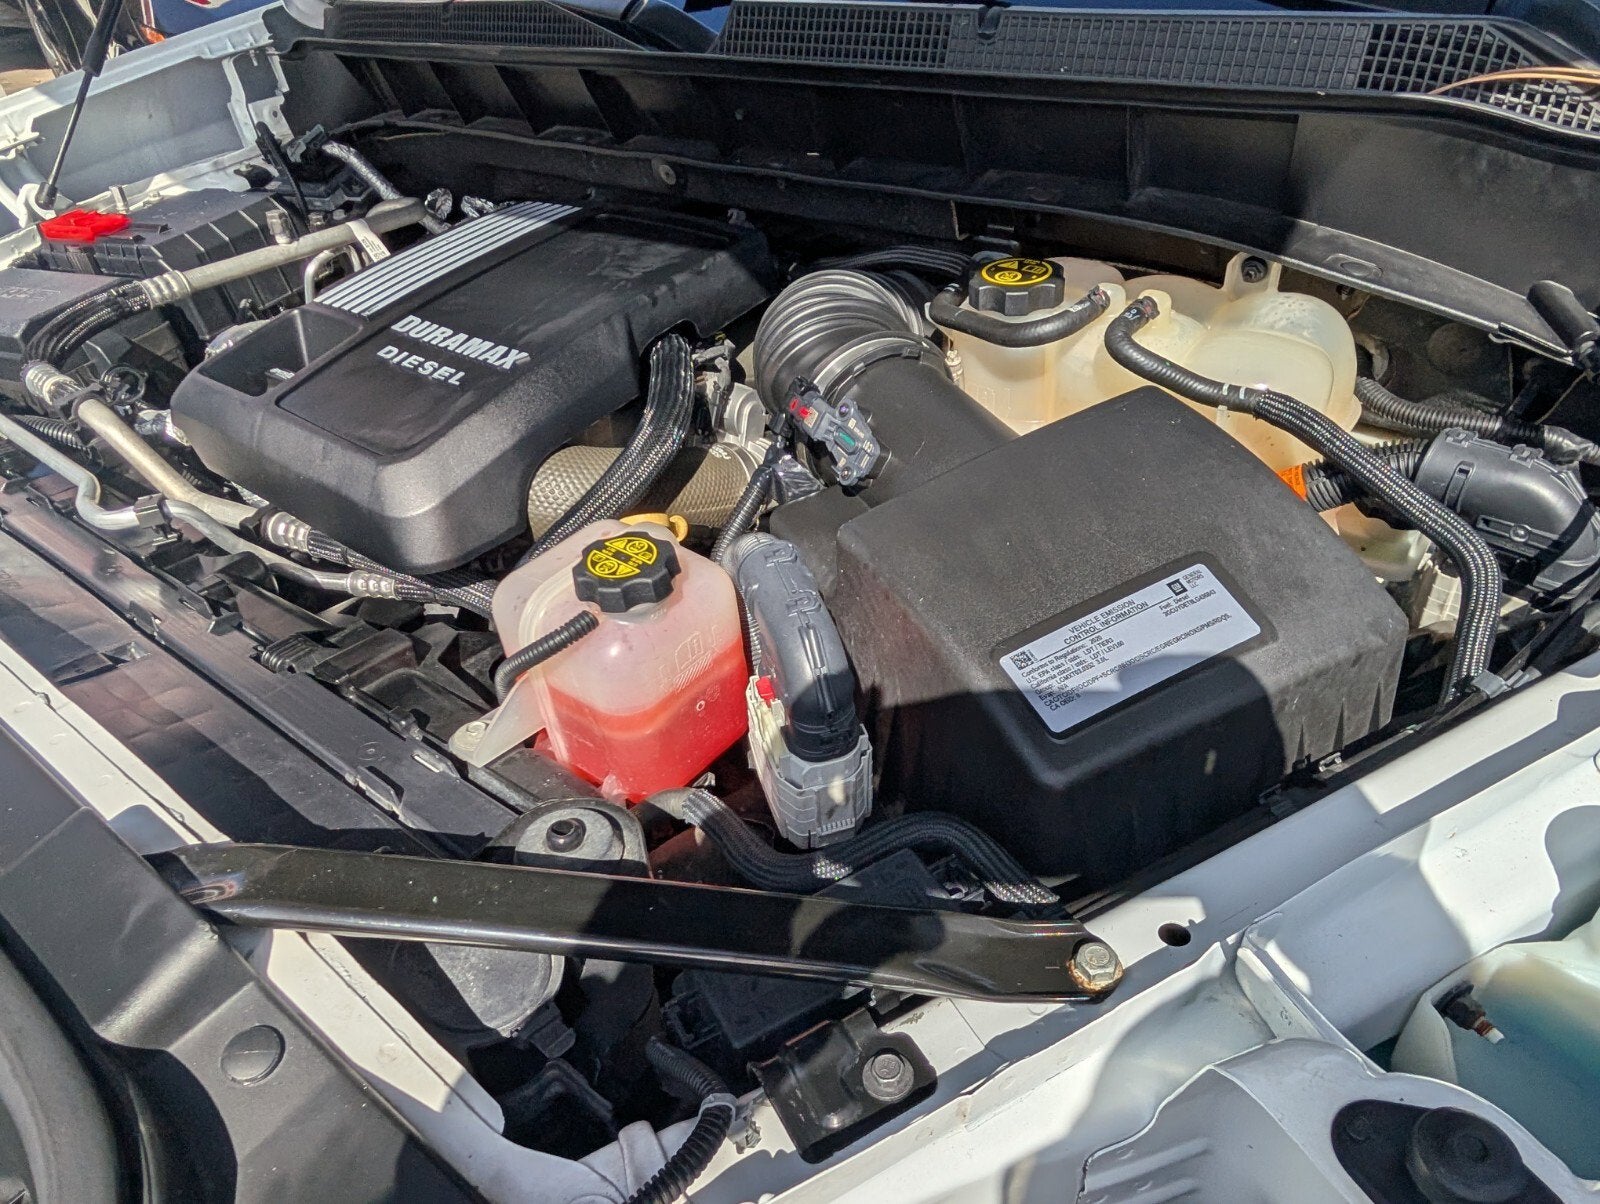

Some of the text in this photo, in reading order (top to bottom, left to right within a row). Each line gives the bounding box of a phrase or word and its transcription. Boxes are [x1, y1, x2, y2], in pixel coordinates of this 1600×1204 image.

[391, 315, 531, 370] DURAMAX
[376, 345, 466, 386] DIESEL
[1069, 599, 1135, 633] VEHICLE EMISSION
[1173, 594, 1190, 604] Diesel
[1064, 602, 1148, 644] CONTROL INFORMATION
[1022, 662, 1048, 677] Conforms
[1089, 635, 1103, 644] 2020
[1031, 674, 1057, 688] California
[1057, 667, 1072, 676] class
[1089, 651, 1101, 660] LDT
[1038, 669, 1050, 678] EPA
[1050, 662, 1065, 672] class
[1083, 647, 1095, 655] LDT
